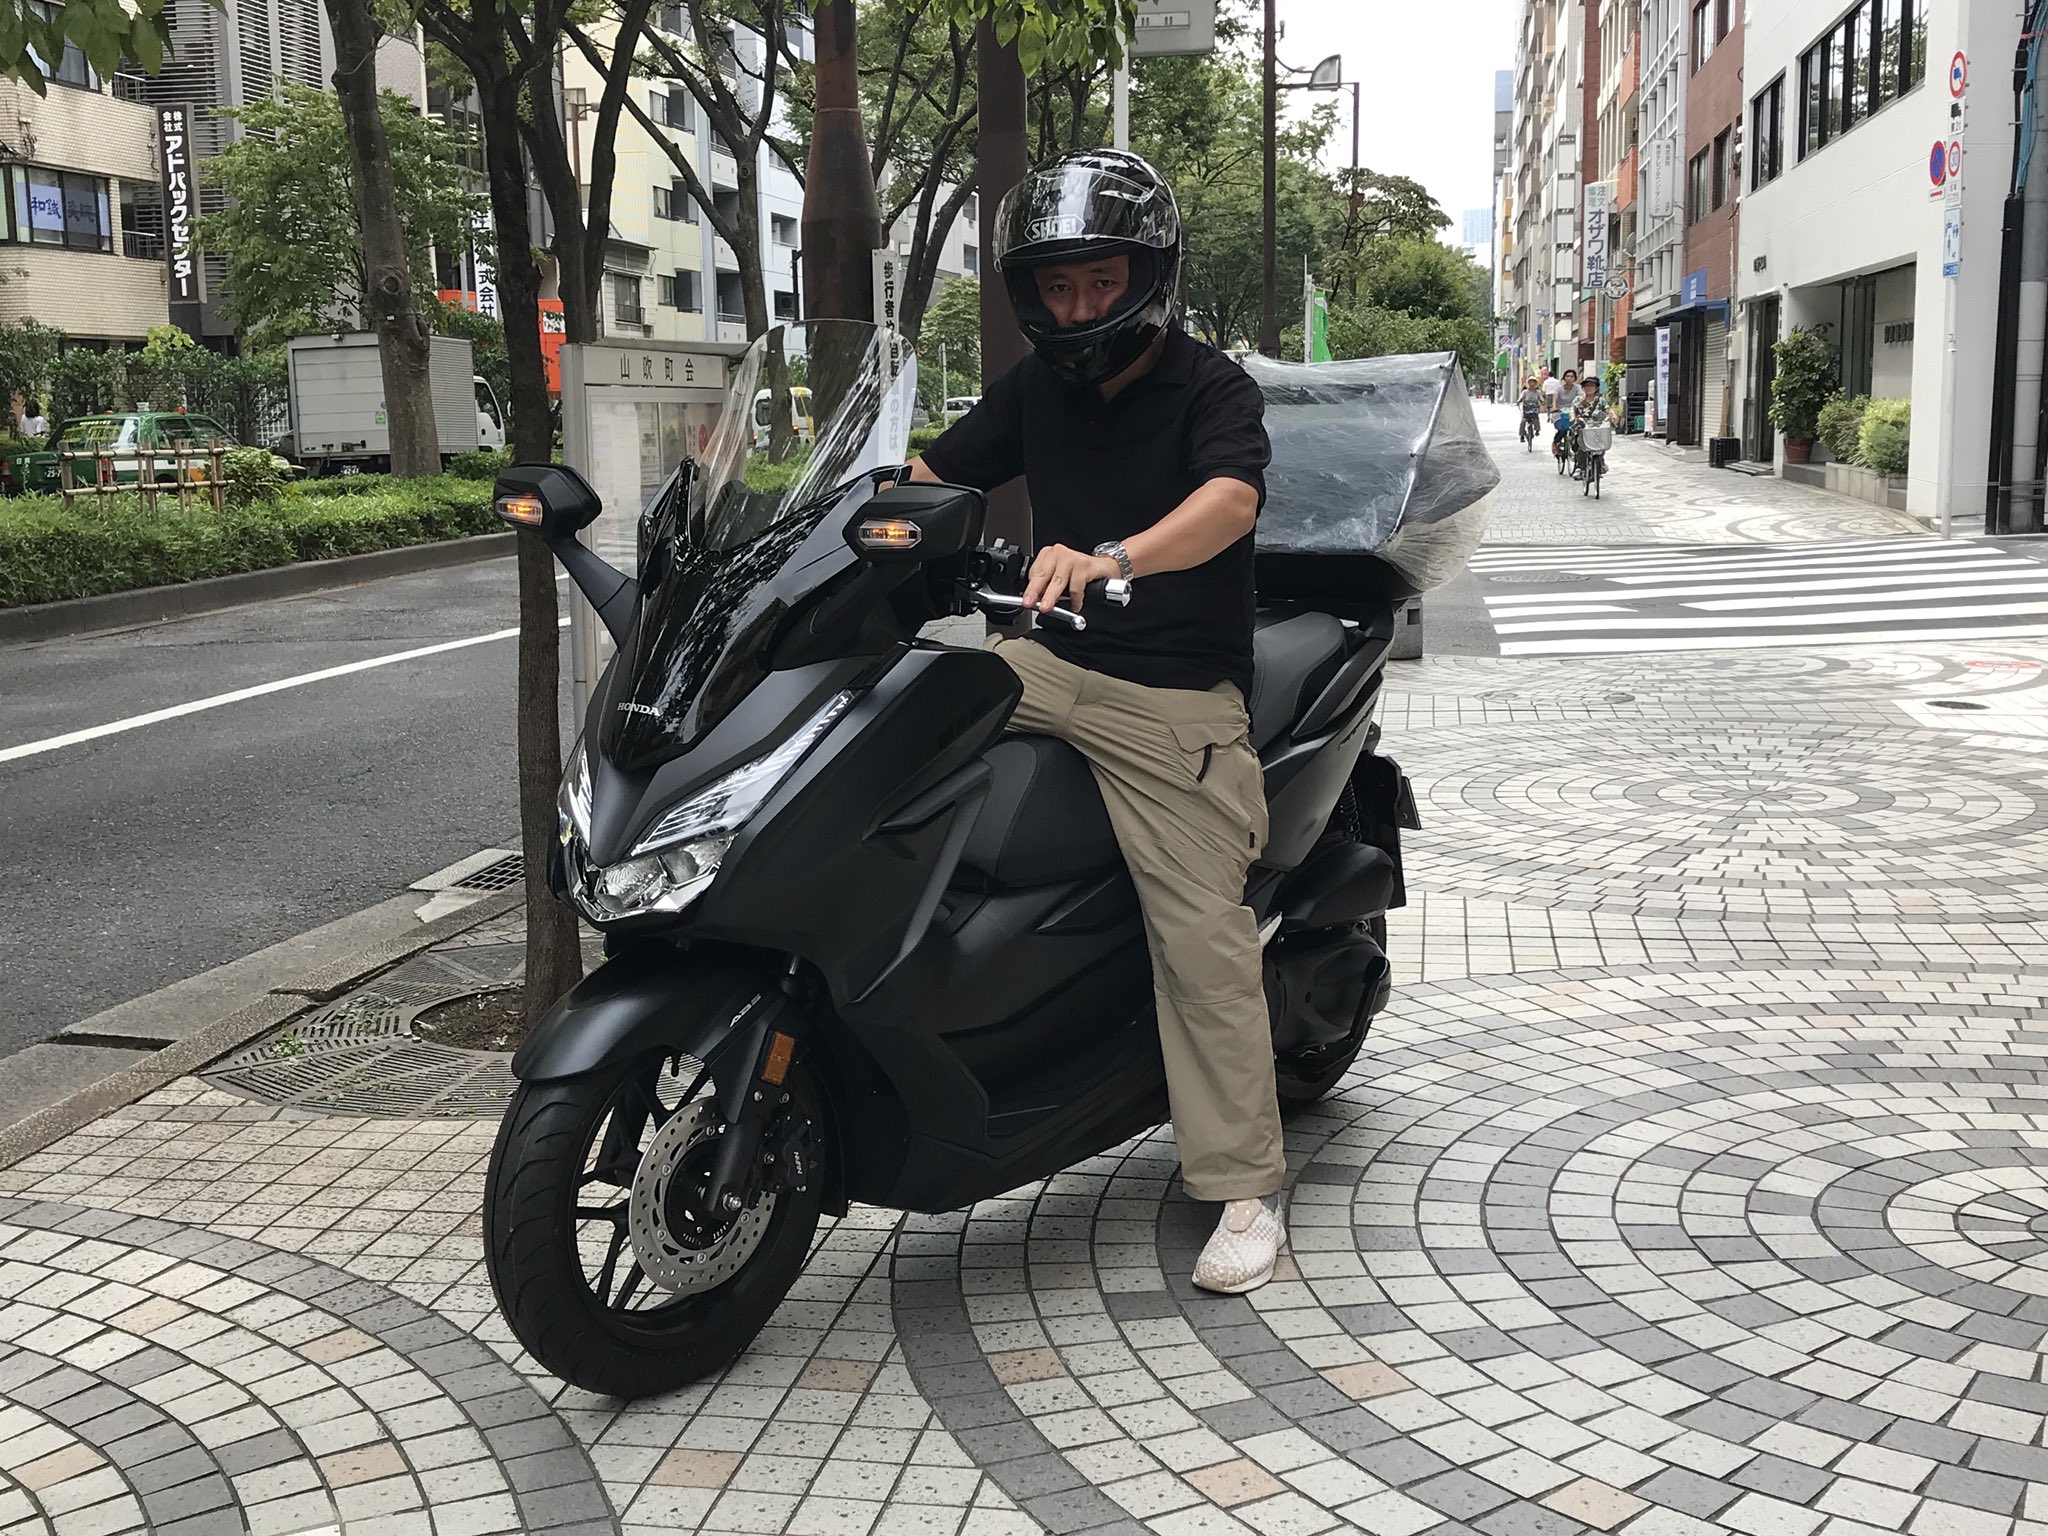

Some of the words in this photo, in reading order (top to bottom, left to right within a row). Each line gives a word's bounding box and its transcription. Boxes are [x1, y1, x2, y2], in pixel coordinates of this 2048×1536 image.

[1588, 186, 1597, 208] 修理
[1597, 186, 1606, 207] 注文
[165, 135, 192, 297] アドパックセンター
[1031, 218, 1077, 240] SHOEI
[1586, 209, 1605, 288] オザワ靴店
[620, 353, 694, 382] 山吹町会
[616, 702, 661, 717] HONDA
